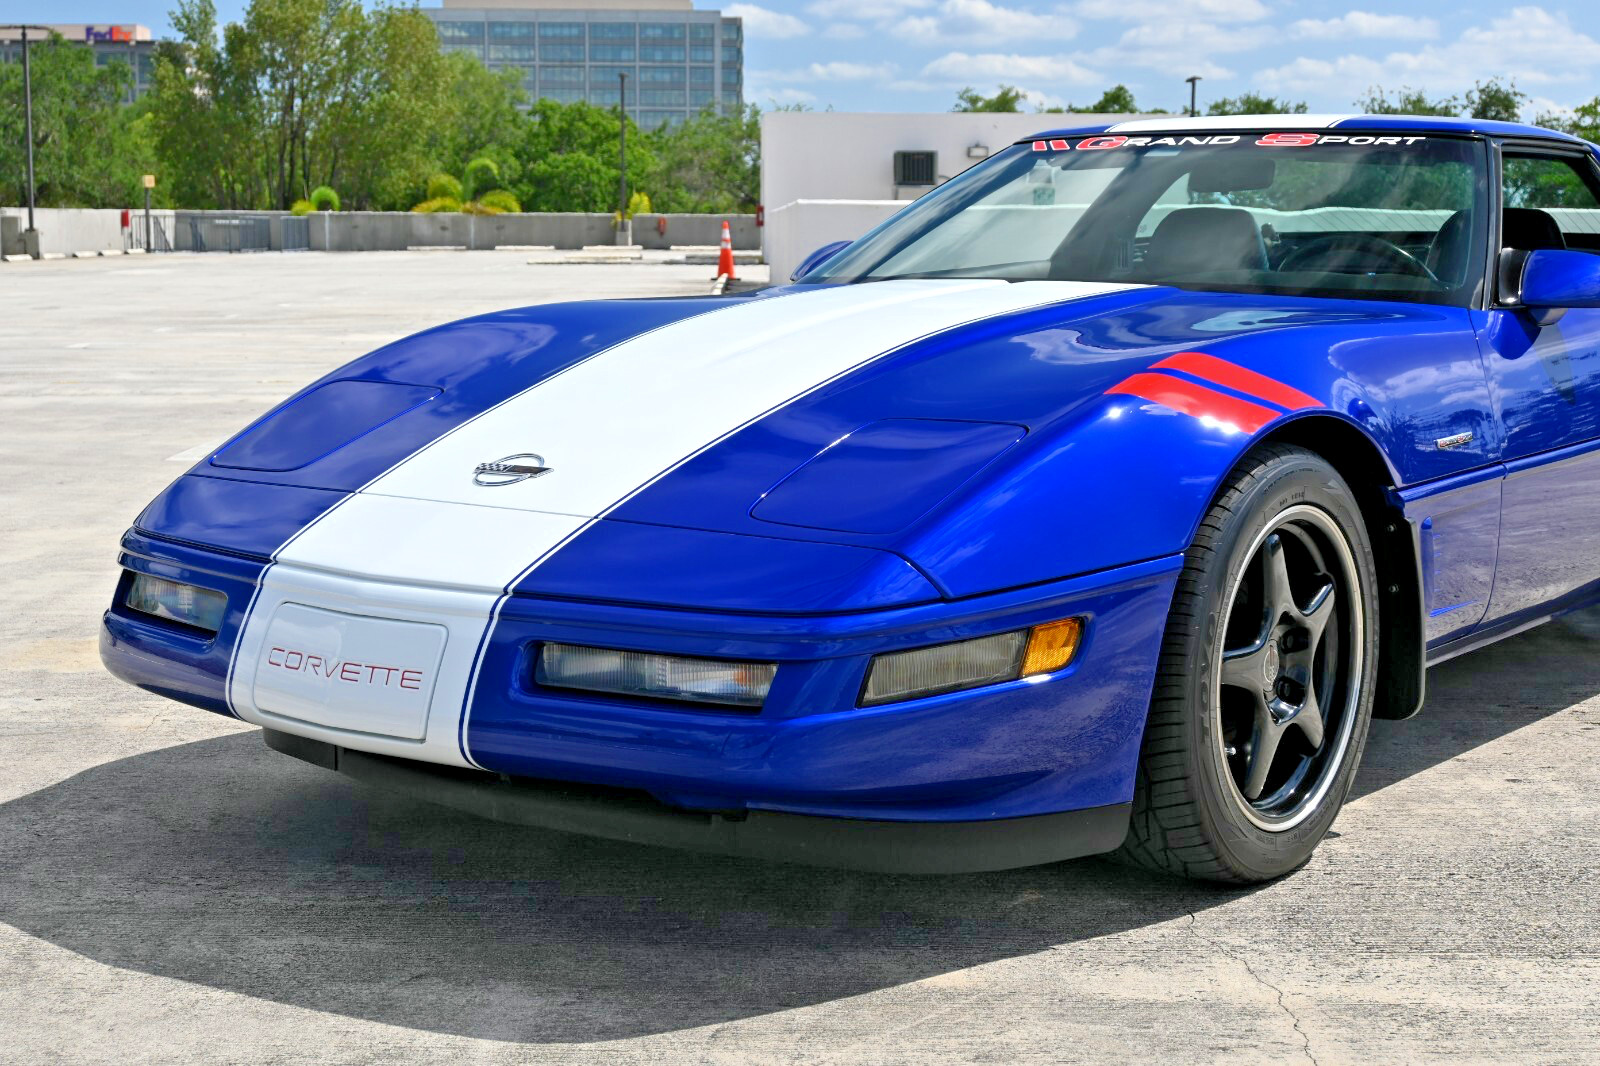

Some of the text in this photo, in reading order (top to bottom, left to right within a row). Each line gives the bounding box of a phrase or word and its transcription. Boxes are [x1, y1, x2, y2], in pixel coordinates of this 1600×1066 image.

[86, 25, 132, 41] FedEx
[1076, 133, 1427, 150] GRAND SPORT
[268, 647, 423, 690] CORVETTE
